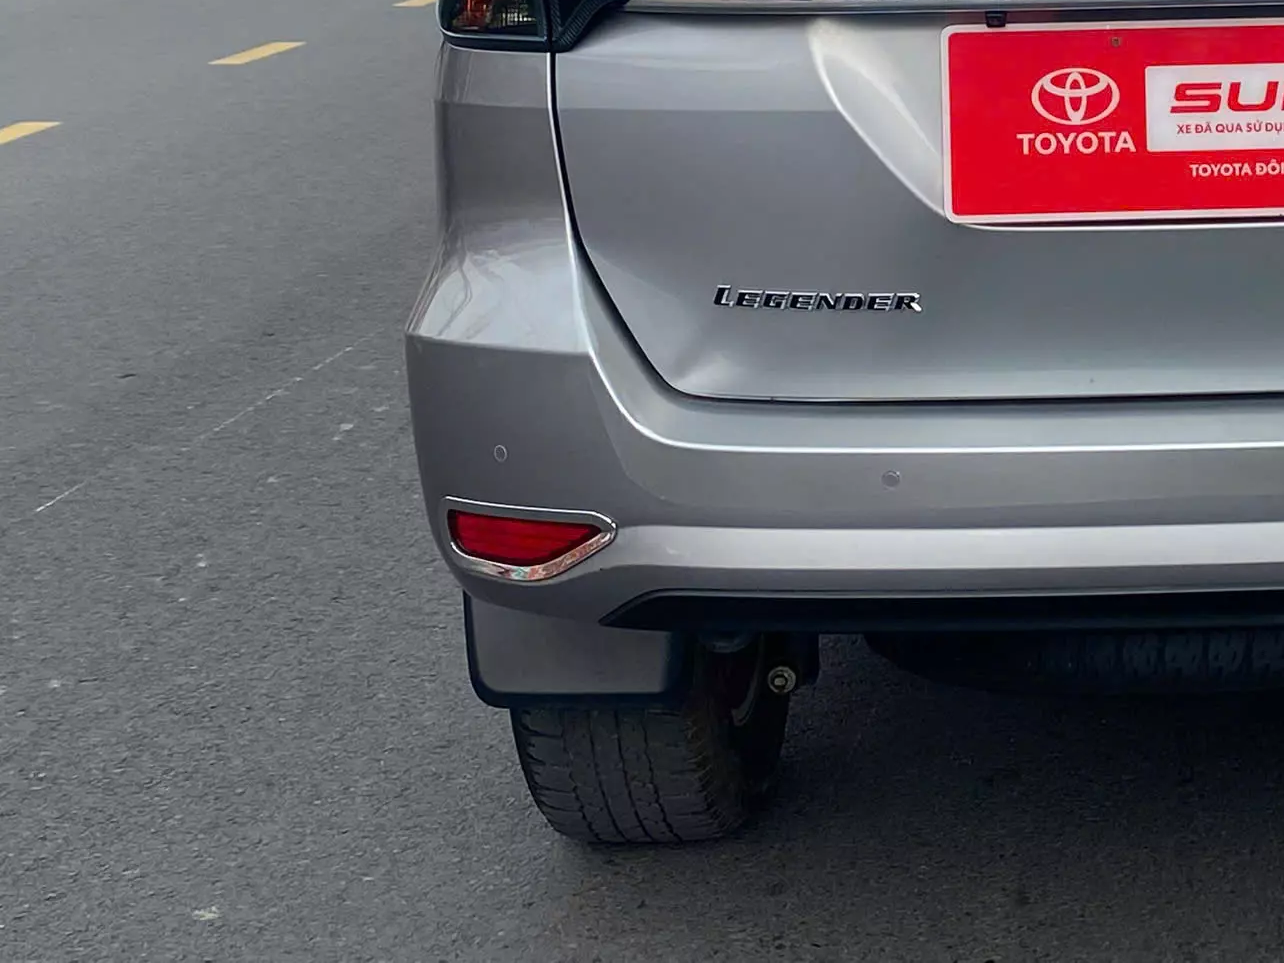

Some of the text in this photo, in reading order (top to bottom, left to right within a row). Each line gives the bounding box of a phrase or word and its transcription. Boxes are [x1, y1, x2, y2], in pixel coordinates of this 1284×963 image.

[1176, 123, 1192, 135] XE
[1194, 121, 1213, 134] ĐÃ
[1215, 122, 1243, 135] QUA
[1246, 118, 1265, 133] SỬ
[1016, 130, 1137, 156] TOYOTA
[1189, 162, 1252, 178] TOYOTA
[713, 284, 923, 313] LEGENDER
